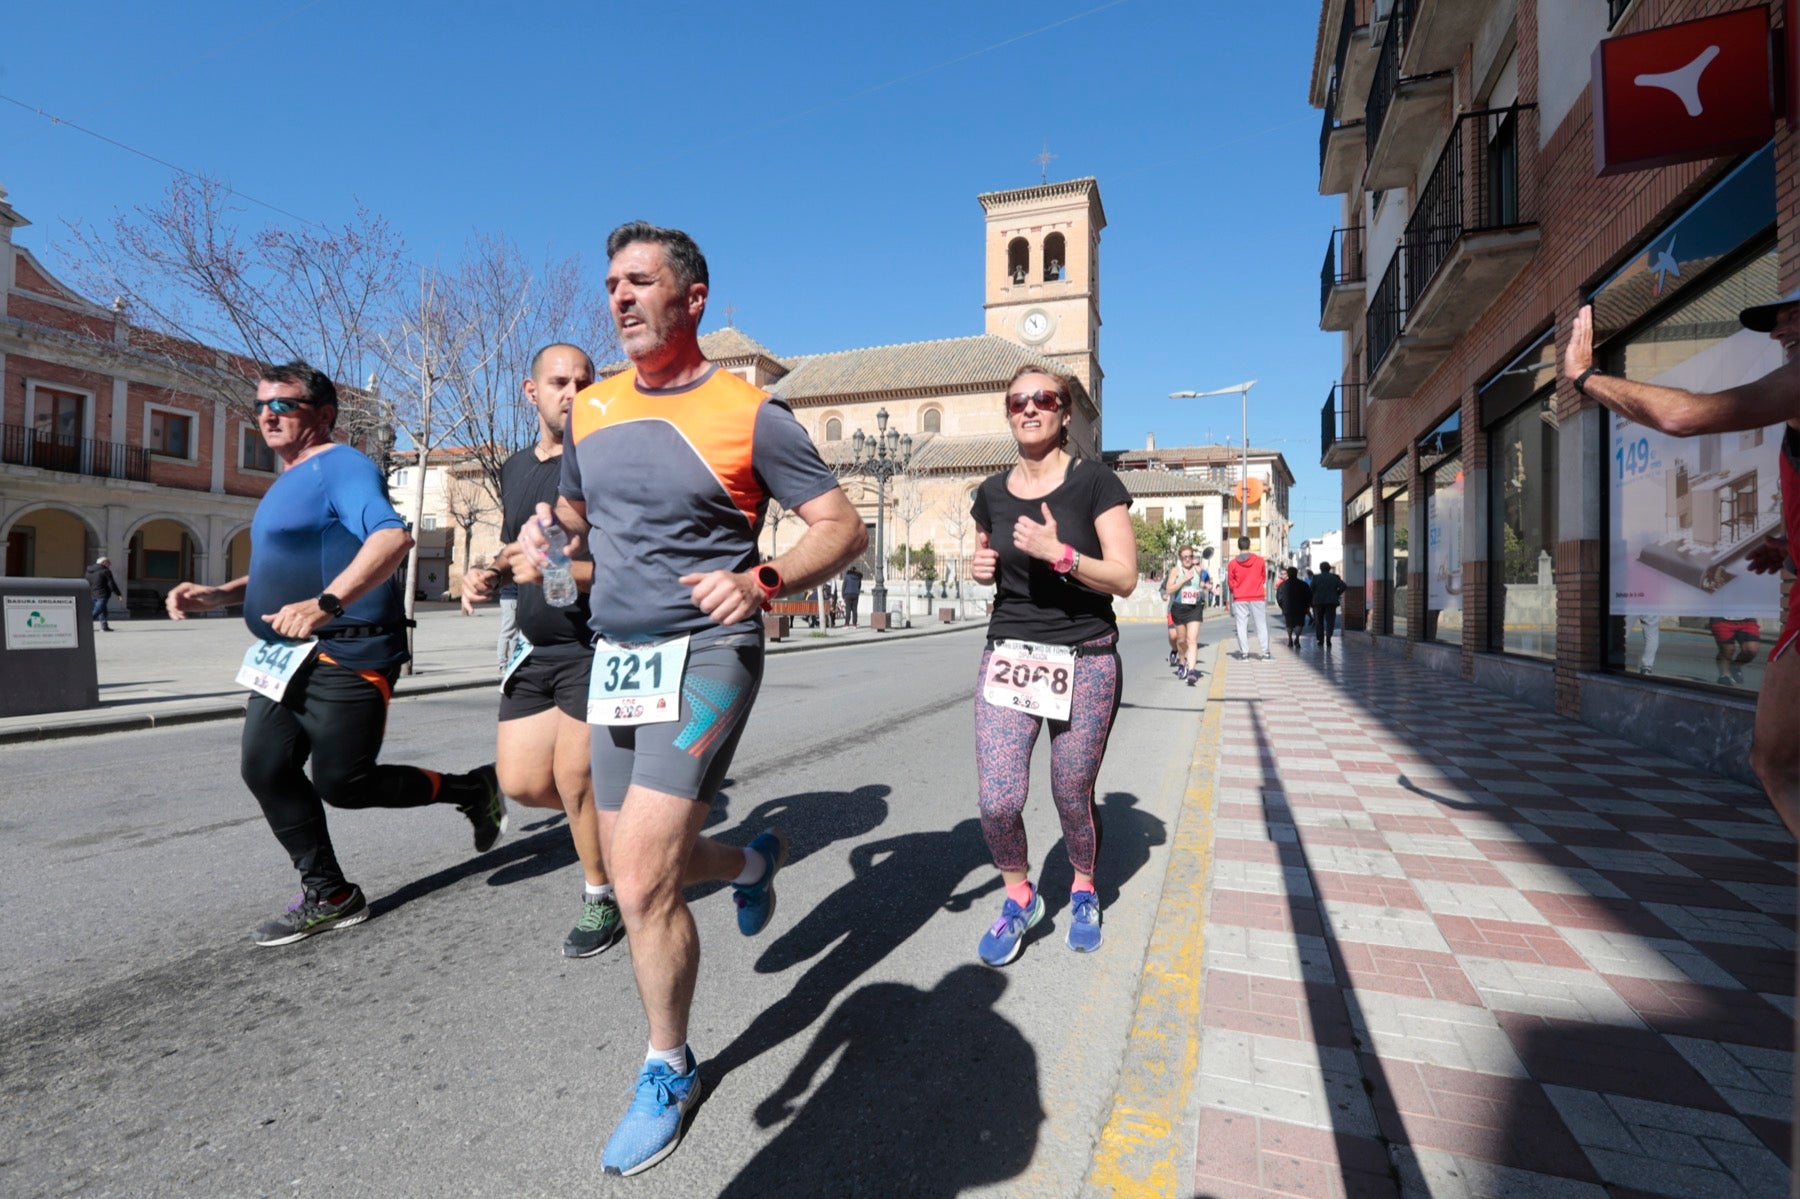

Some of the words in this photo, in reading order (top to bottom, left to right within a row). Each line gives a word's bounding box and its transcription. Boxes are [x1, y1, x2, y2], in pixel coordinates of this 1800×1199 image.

[1615, 436, 1649, 480] 149
[254, 643, 294, 674] 544
[604, 651, 662, 692] 321
